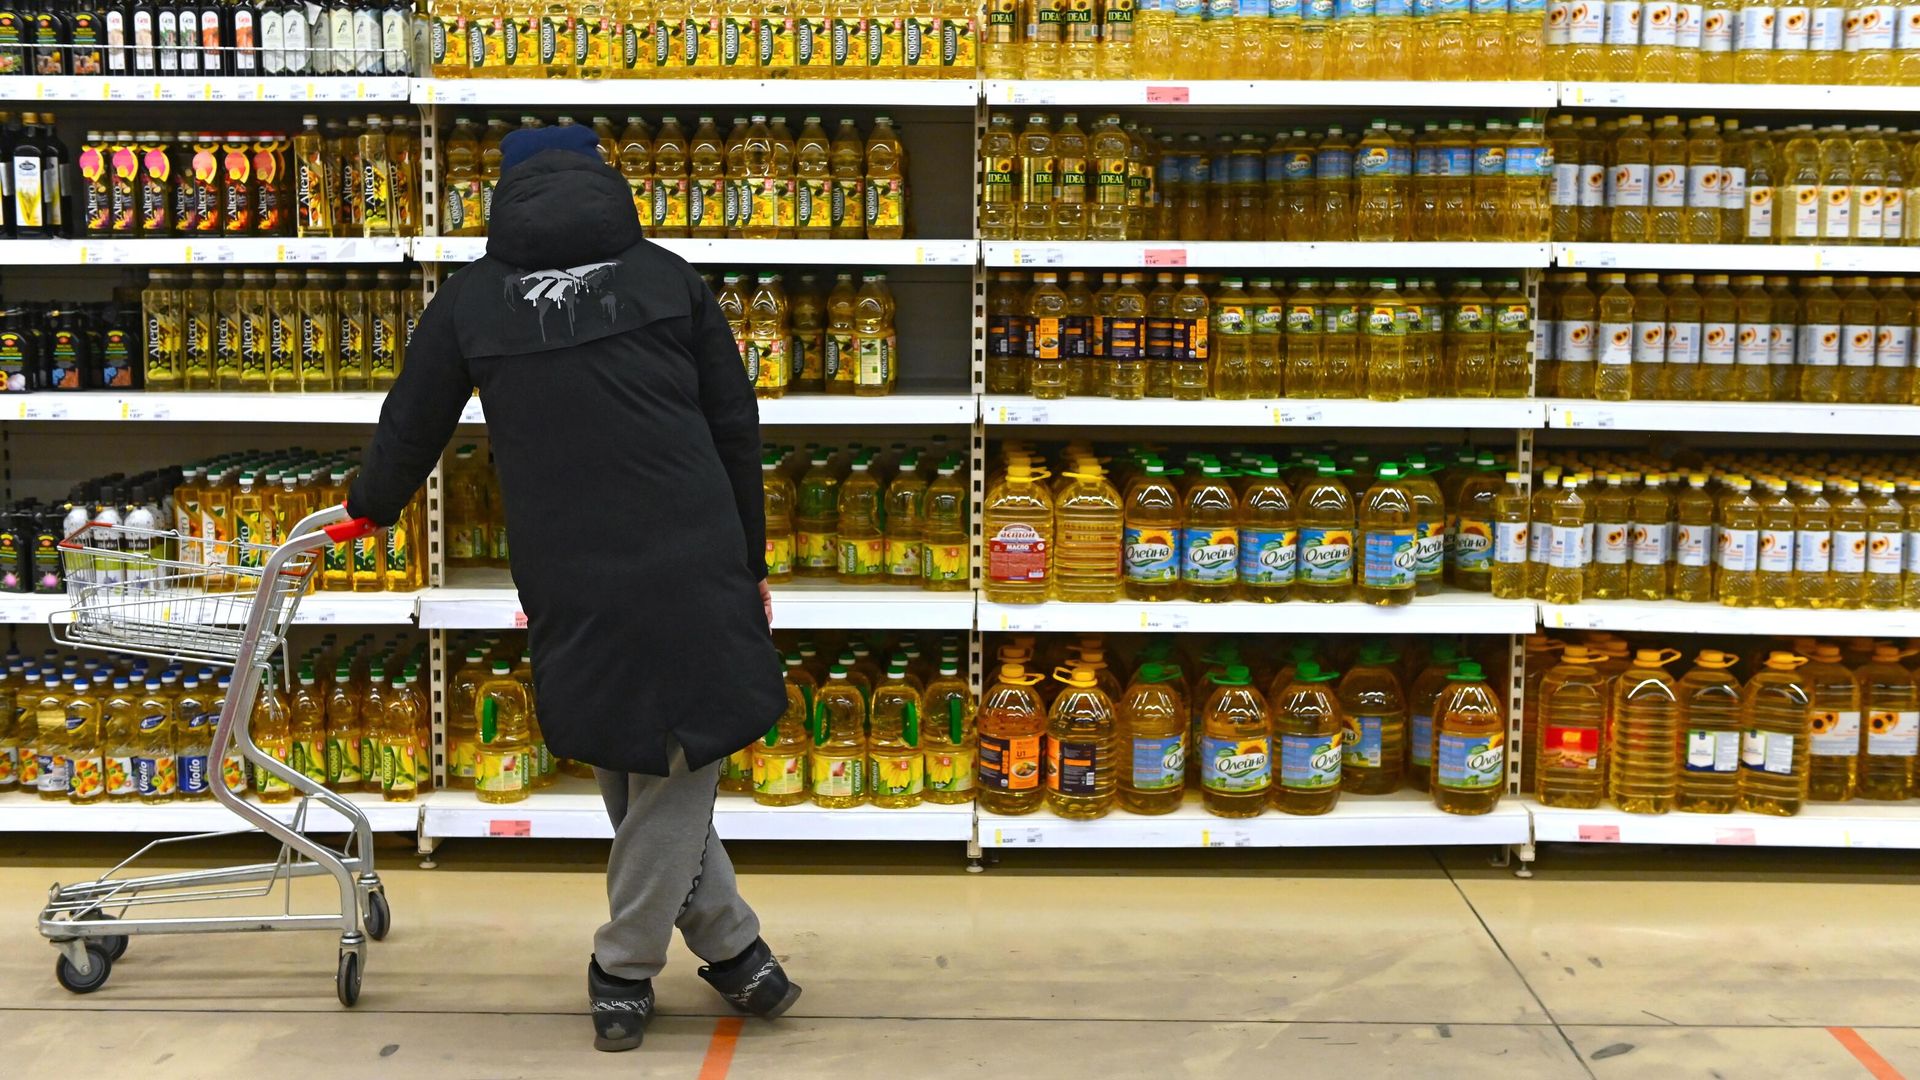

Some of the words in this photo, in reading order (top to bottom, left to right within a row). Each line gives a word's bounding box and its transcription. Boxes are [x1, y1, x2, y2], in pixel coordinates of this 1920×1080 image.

[991, 12, 1015, 23] IDEAL
[1041, 12, 1060, 21] IDEA
[1108, 12, 1131, 21] IDEAL
[300, 165, 310, 207] Altero
[344, 165, 353, 203] Altero
[365, 165, 375, 207] Altero
[988, 173, 1010, 183] IDEAL
[1065, 174, 1085, 183] IDEA
[1101, 174, 1124, 183] IDEAL
[88, 185, 98, 219] Altero
[114, 185, 123, 220] Altero
[144, 185, 153, 220] Altero
[176, 186, 186, 218] Altero
[197, 185, 207, 220] Altero
[227, 185, 237, 220] Altero
[258, 185, 268, 219] Altero
[150, 318, 160, 358] Altero
[187, 318, 197, 357] Altero
[218, 318, 228, 357] Altero
[243, 320, 253, 359] Altero
[272, 319, 282, 358] Altero
[303, 319, 313, 358] Altero
[341, 319, 350, 357] Altero
[373, 319, 382, 358] Altero
[1126, 544, 1169, 560] Олейна
[1192, 544, 1237, 562] Олейна
[1306, 548, 1349, 561] Олейна
[1219, 756, 1264, 771] Олейна
